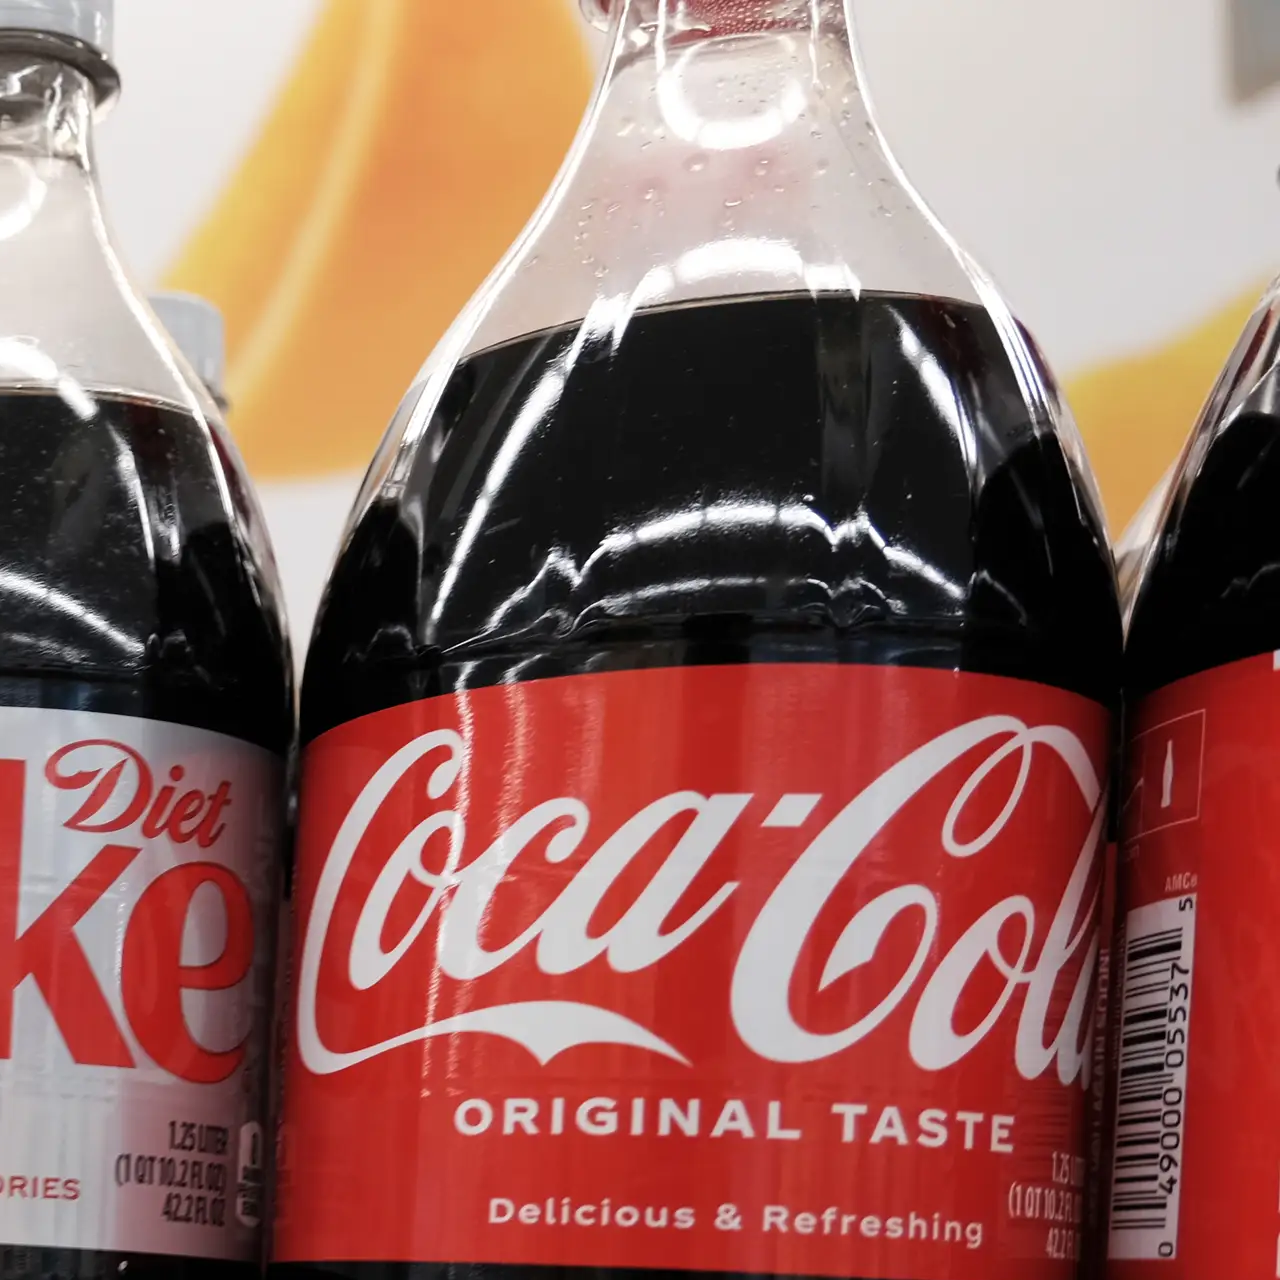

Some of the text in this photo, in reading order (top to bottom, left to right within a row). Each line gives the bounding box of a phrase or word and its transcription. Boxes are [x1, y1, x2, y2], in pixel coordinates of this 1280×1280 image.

[44, 738, 232, 848] Diet
[1165, 961, 1190, 1070] 05537
[168, 1120, 197, 1152] 1.25
[452, 1095, 1017, 1154] ORIGINAL TASTE
[1158, 1086, 1183, 1196] 49000
[161, 1191, 194, 1223] 42.2
[488, 1196, 984, 1250] Delicious & Refreshing
